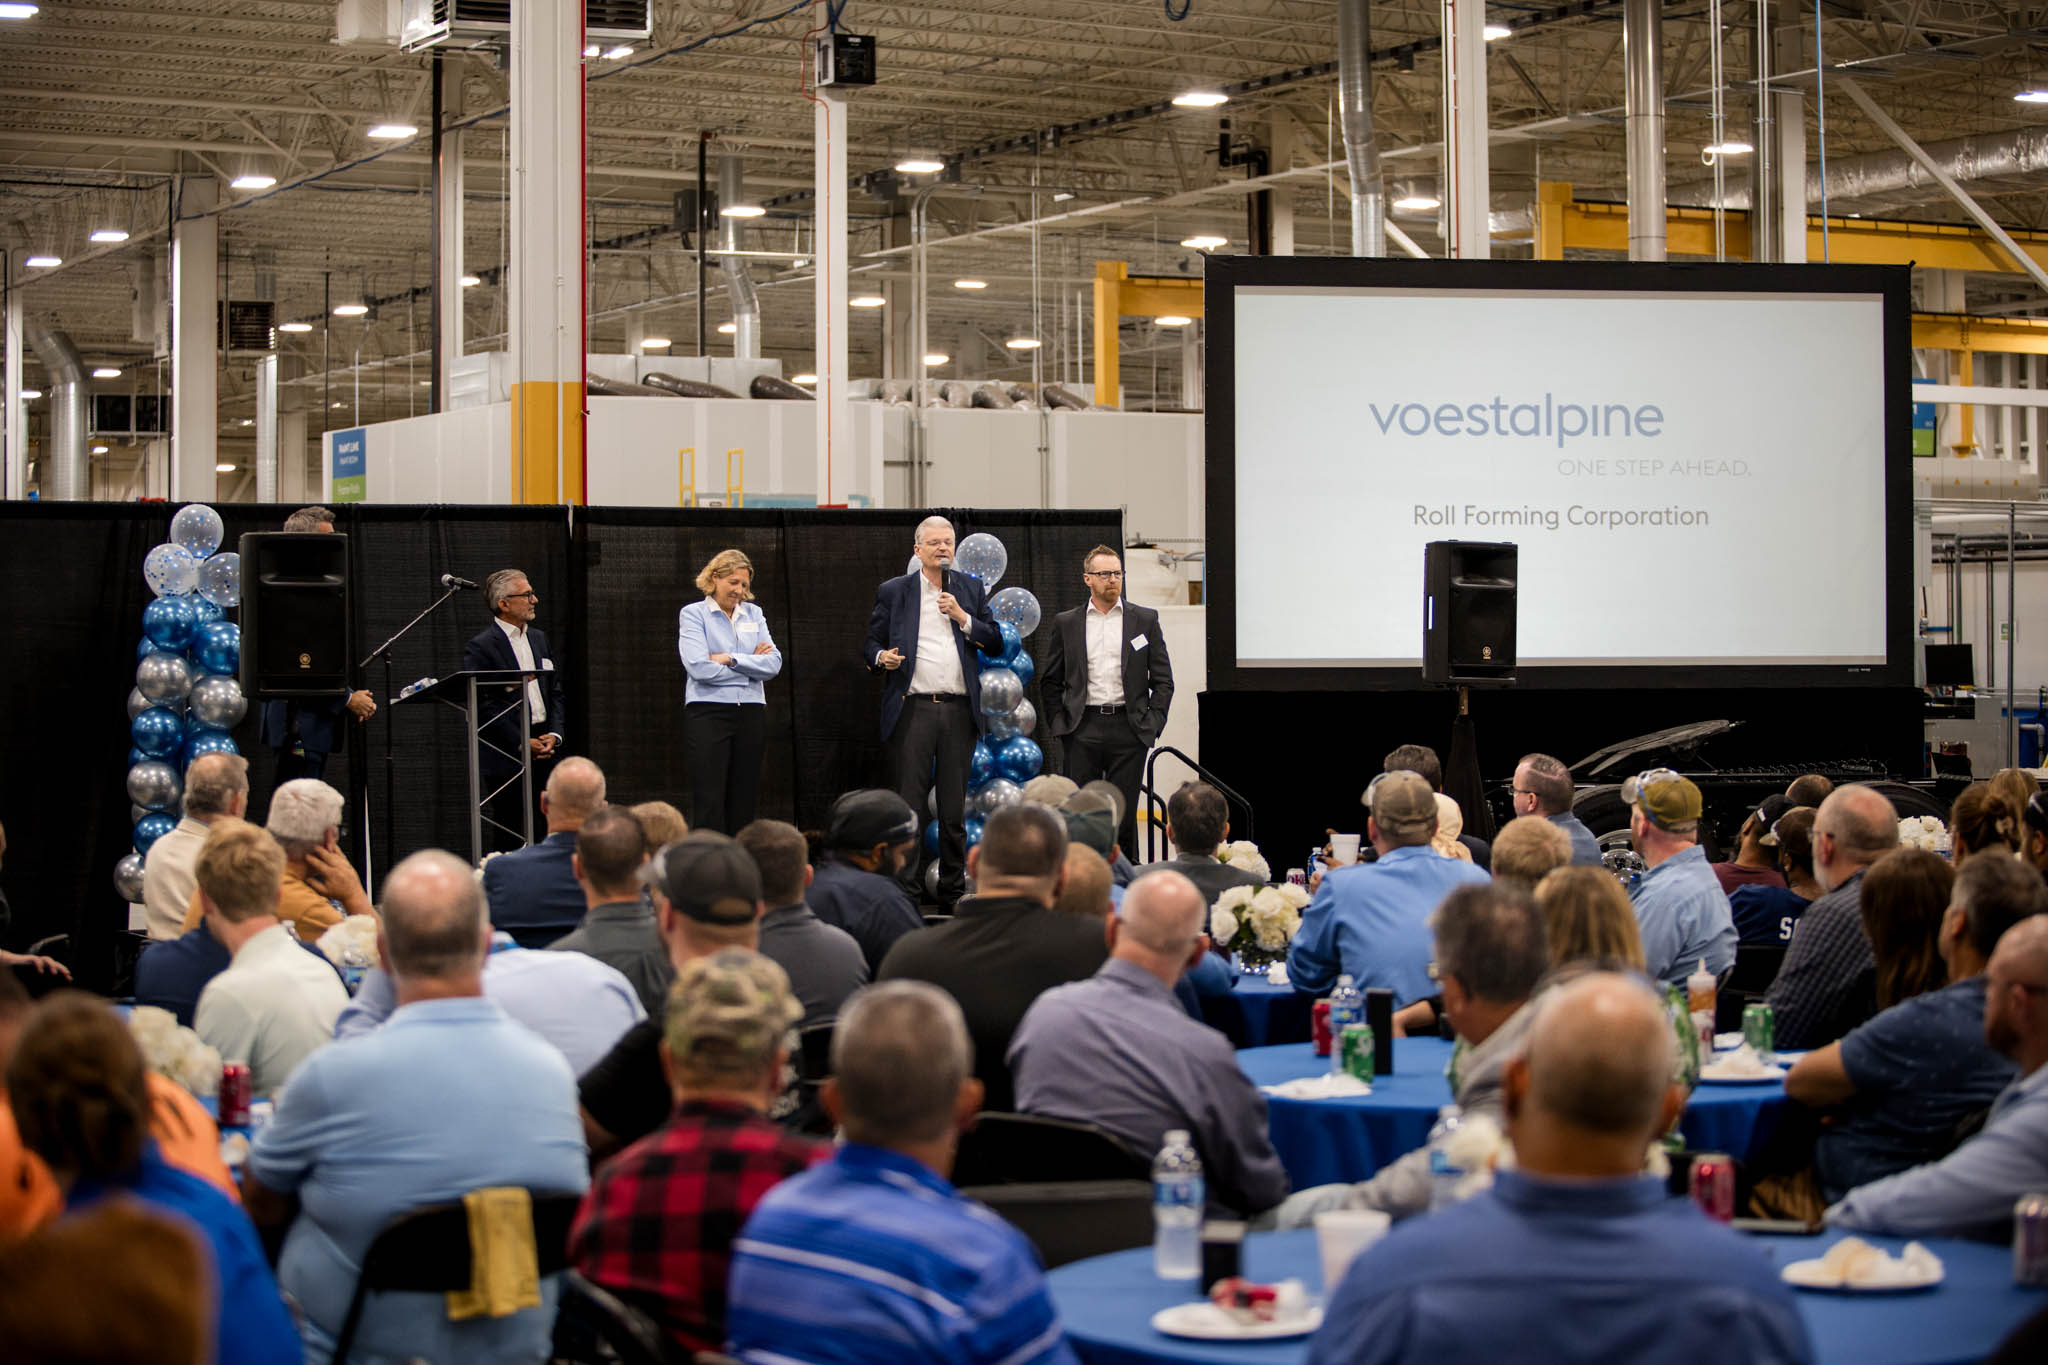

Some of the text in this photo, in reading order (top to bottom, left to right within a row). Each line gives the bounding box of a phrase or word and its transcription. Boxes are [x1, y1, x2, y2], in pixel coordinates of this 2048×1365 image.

[1368, 393, 1665, 449] voestalpine
[1558, 459, 1752, 477] ONE STEP AHEAD.
[1414, 504, 1709, 531] Roll Forming Corporation
